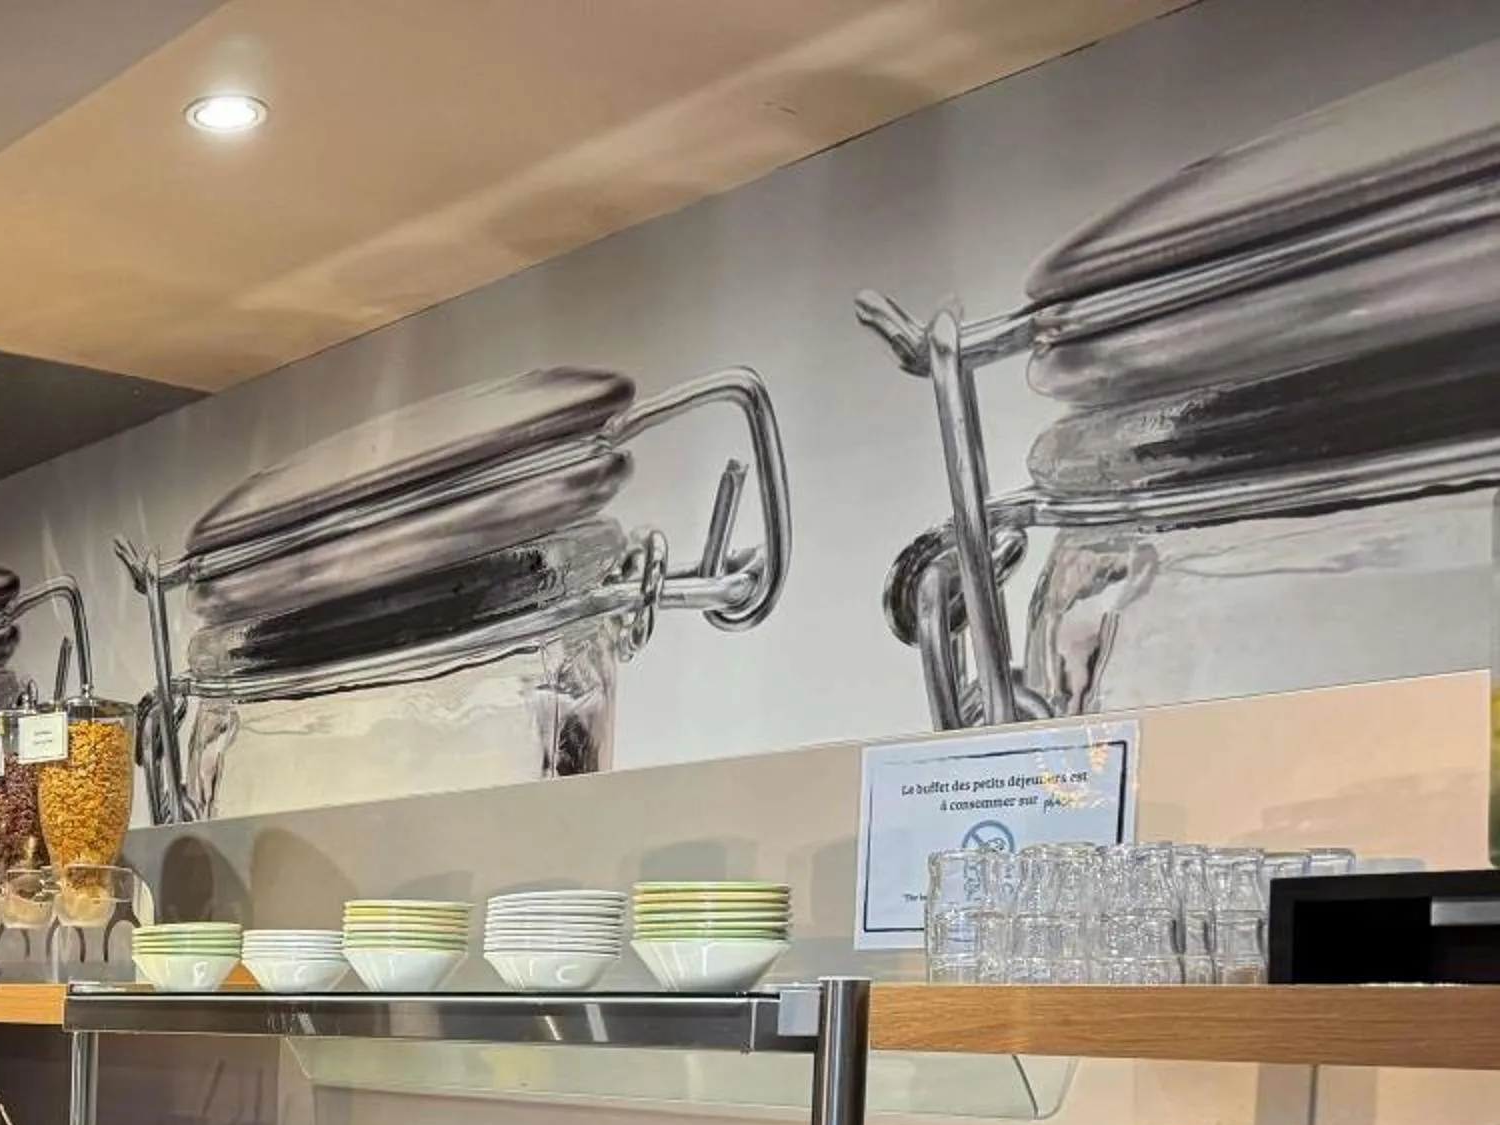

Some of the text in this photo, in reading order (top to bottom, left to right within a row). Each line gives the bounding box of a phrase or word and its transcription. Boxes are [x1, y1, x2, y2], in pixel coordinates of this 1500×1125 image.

[901, 784, 915, 796] Le
[916, 780, 950, 795] buffet
[952, 778, 971, 791] des
[973, 776, 1005, 793] petits
[1070, 771, 1088, 783] est
[950, 798, 1015, 811] consommer
[1018, 795, 1038, 807] sur
